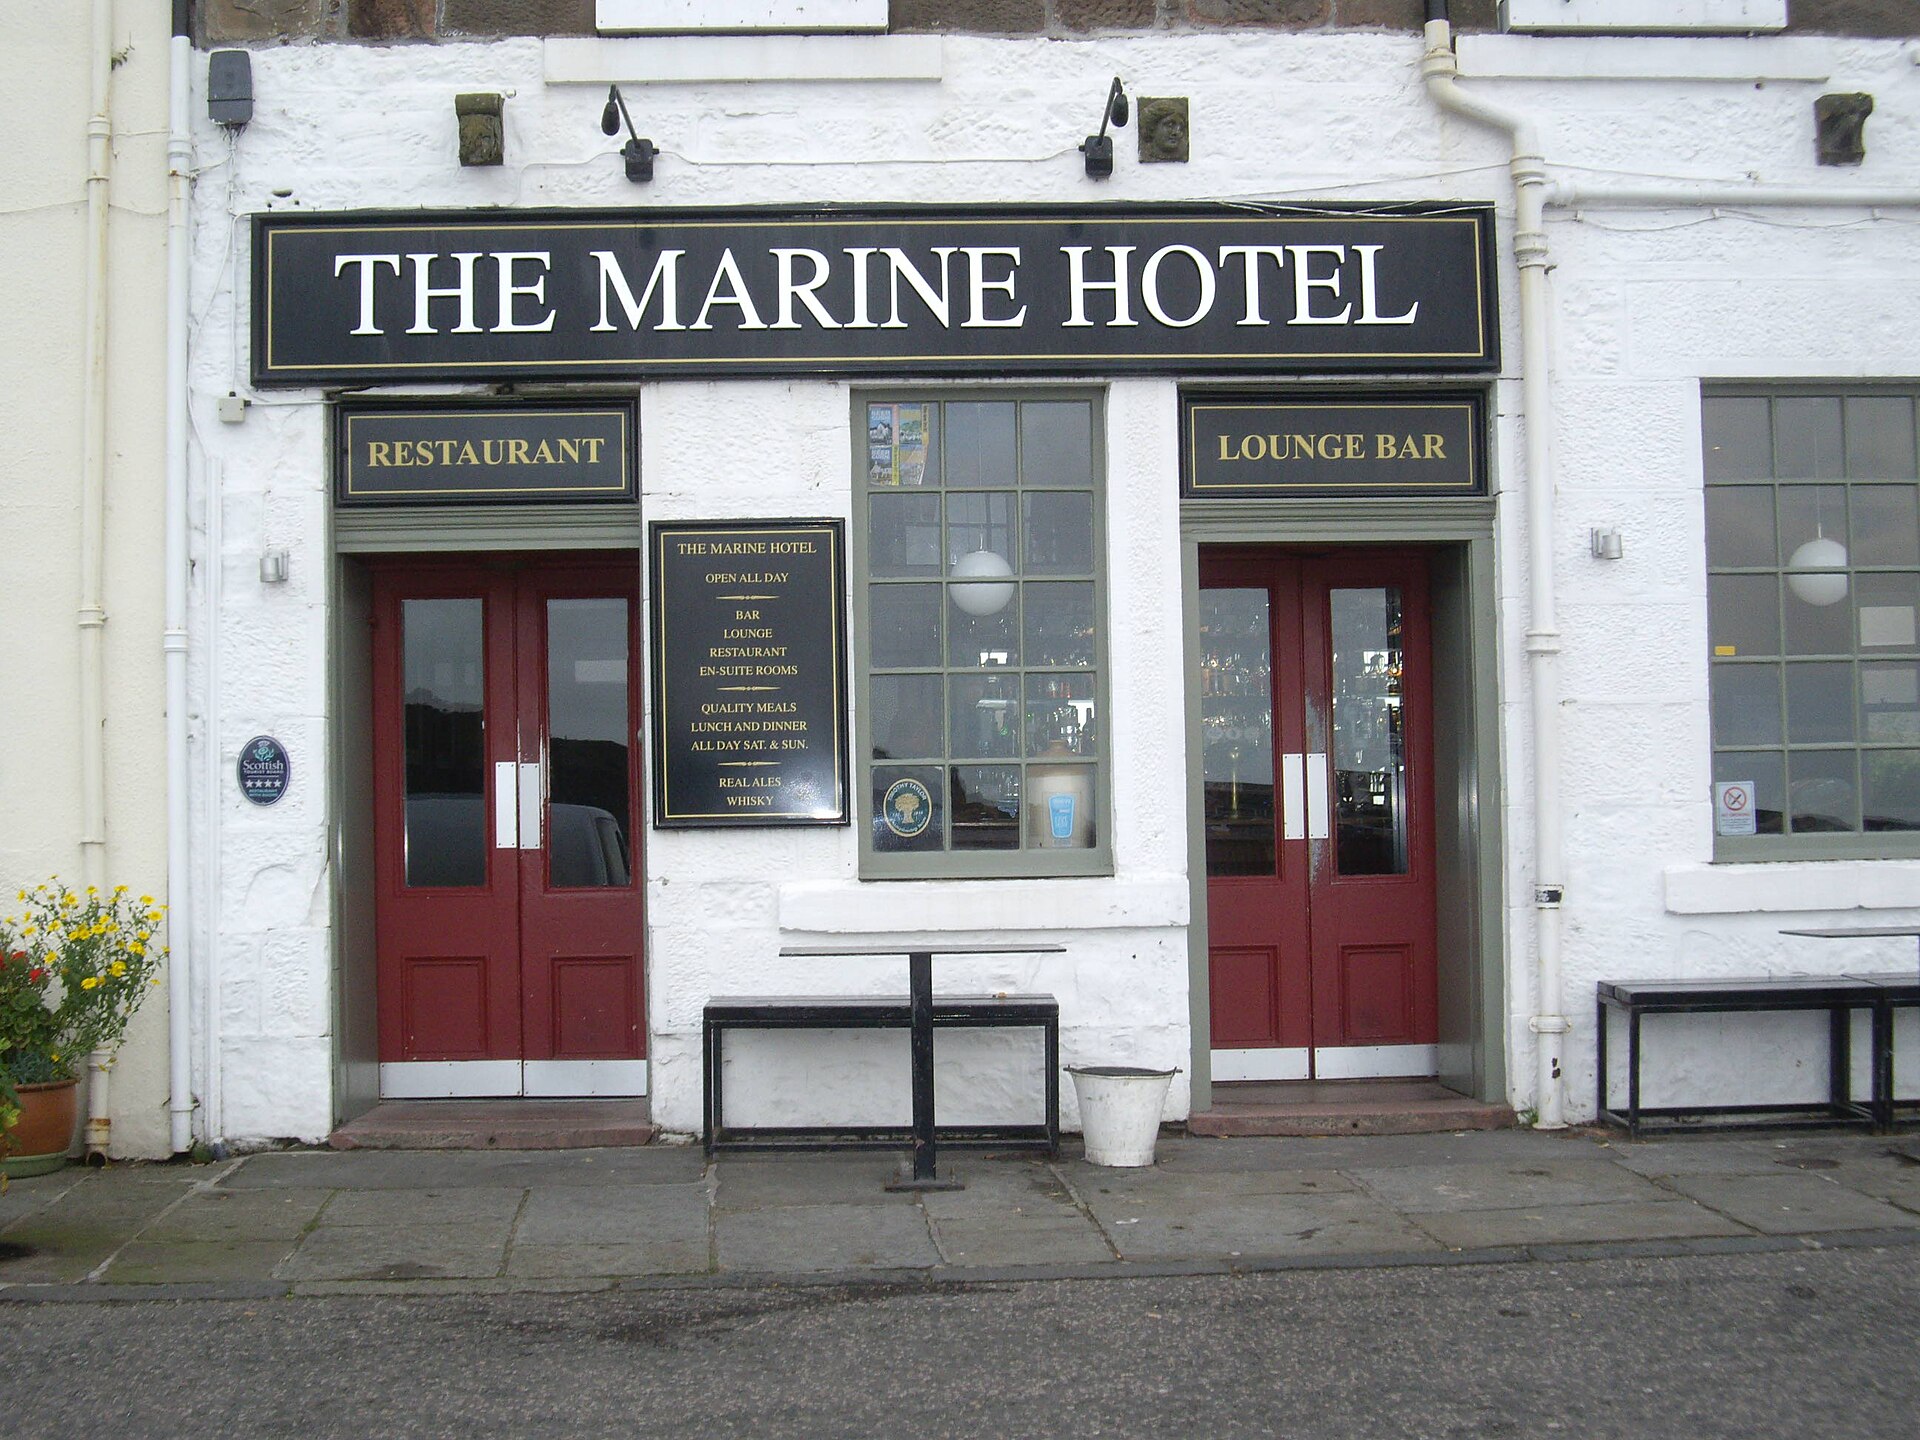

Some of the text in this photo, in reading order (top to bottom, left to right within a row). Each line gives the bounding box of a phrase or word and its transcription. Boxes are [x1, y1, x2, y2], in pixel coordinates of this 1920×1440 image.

[335, 245, 1418, 334] THE MARINE HOTEL
[1219, 434, 1446, 459] LOUNGE BAR
[368, 439, 604, 466] RESTAURANT
[678, 542, 816, 554] THE MARINE HOTEL
[706, 573, 789, 583] OPEN ALL DAY
[736, 611, 760, 620] BAR
[724, 629, 772, 639] LOUNGE
[710, 647, 787, 657] RESTAURANT
[700, 665, 798, 676] EN-SUITE ROOMS
[701, 703, 797, 713] QUALITY MEALS
[691, 721, 807, 732] LUNCH AND DINNER
[691, 739, 808, 751] ALL DAY SAT. & SUN.
[243, 759, 284, 770] Scottish
[719, 777, 781, 787] REAL ALES
[909, 783, 927, 801] TAYLOR
[727, 796, 774, 806] WHISKY
